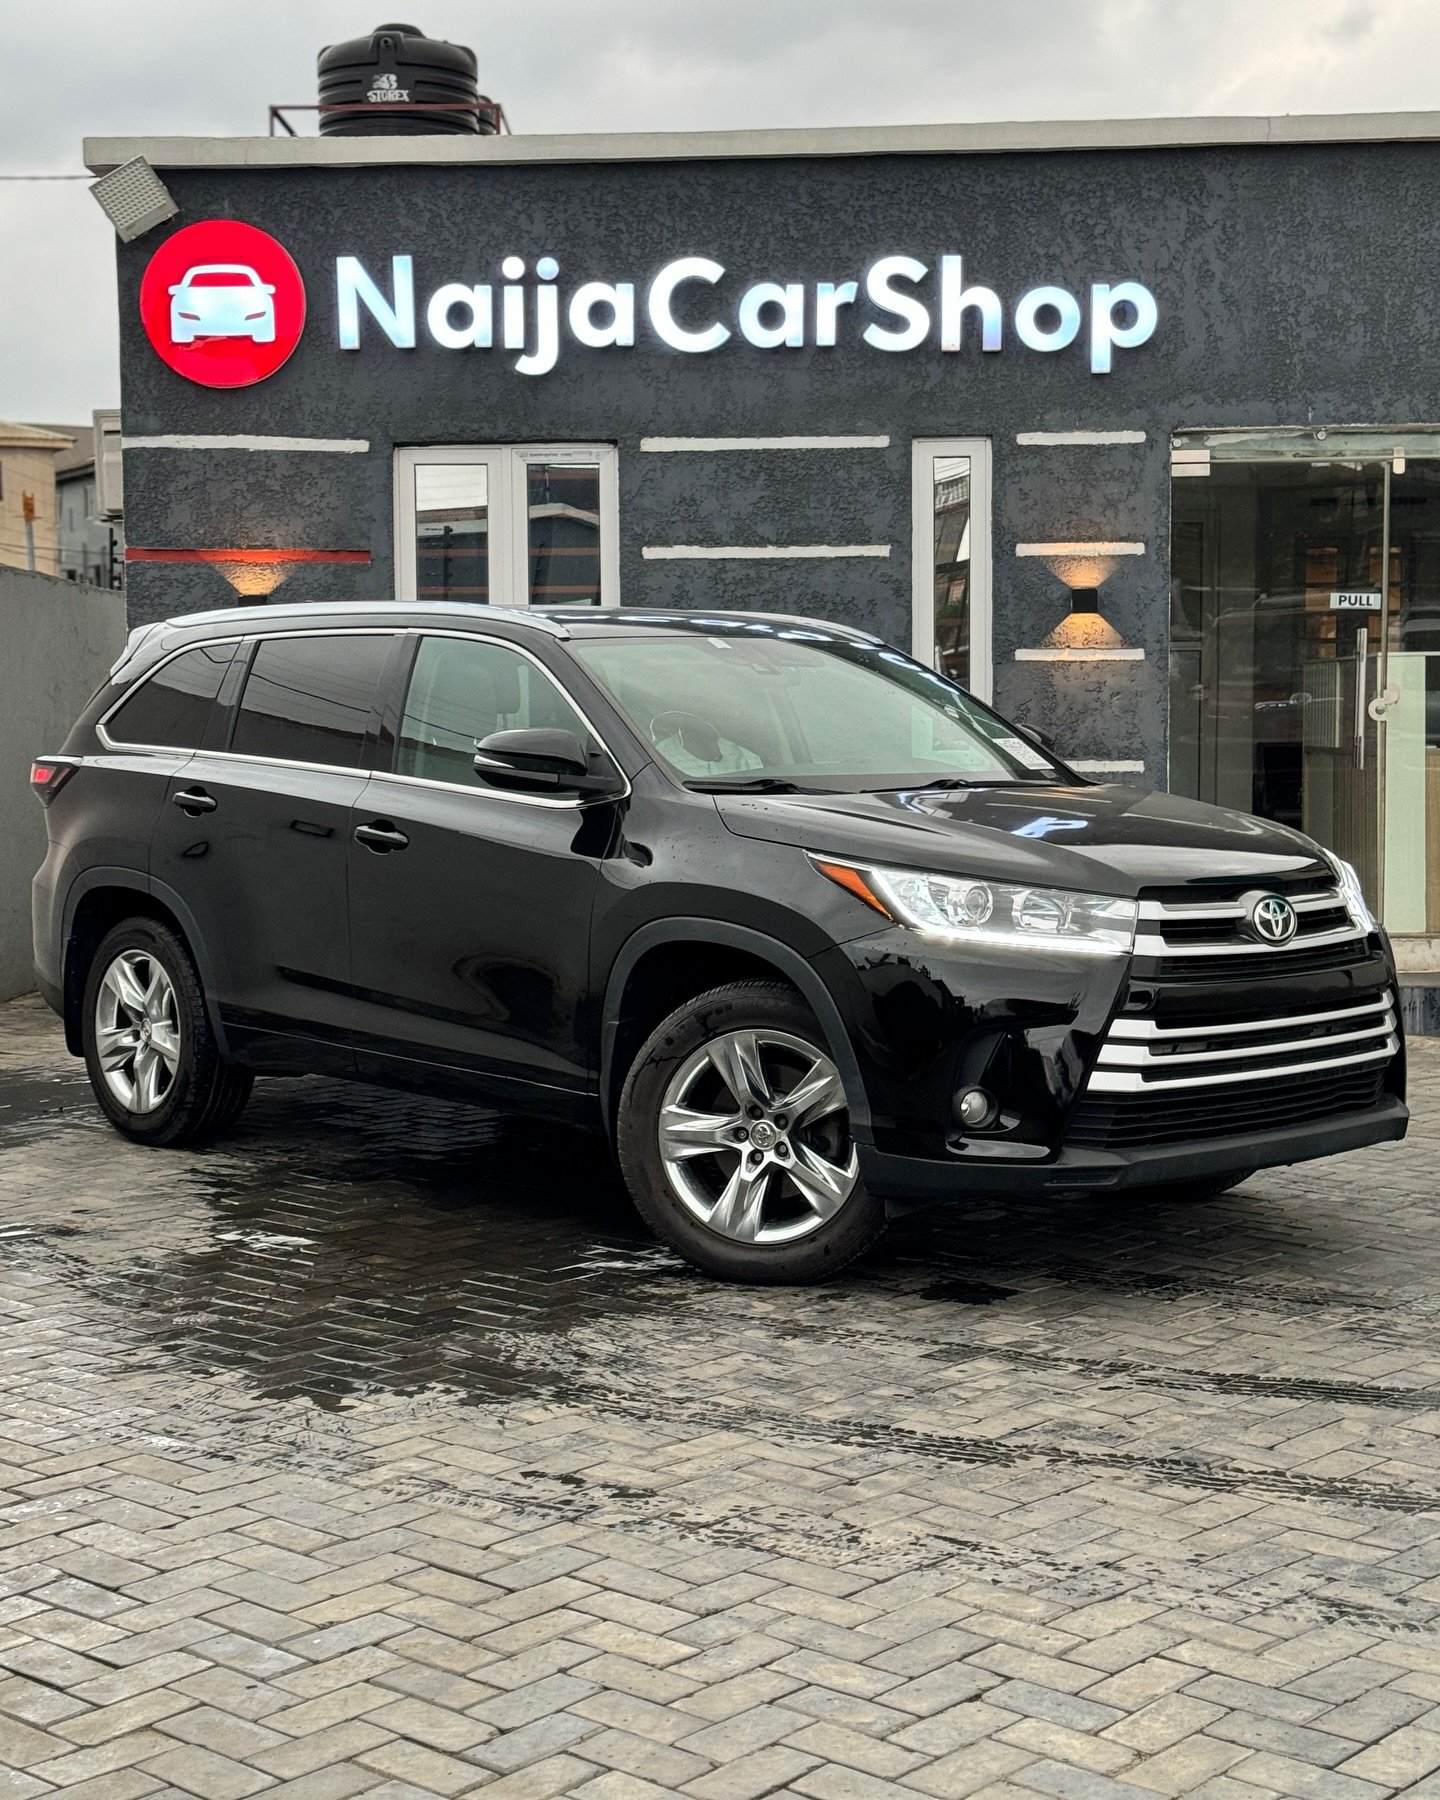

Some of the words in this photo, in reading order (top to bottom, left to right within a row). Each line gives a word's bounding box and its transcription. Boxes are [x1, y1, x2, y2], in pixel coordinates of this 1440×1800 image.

[366, 89, 410, 103] STOREX
[335, 254, 1159, 375] NaijaCarShop
[1338, 595, 1373, 606] PULL
